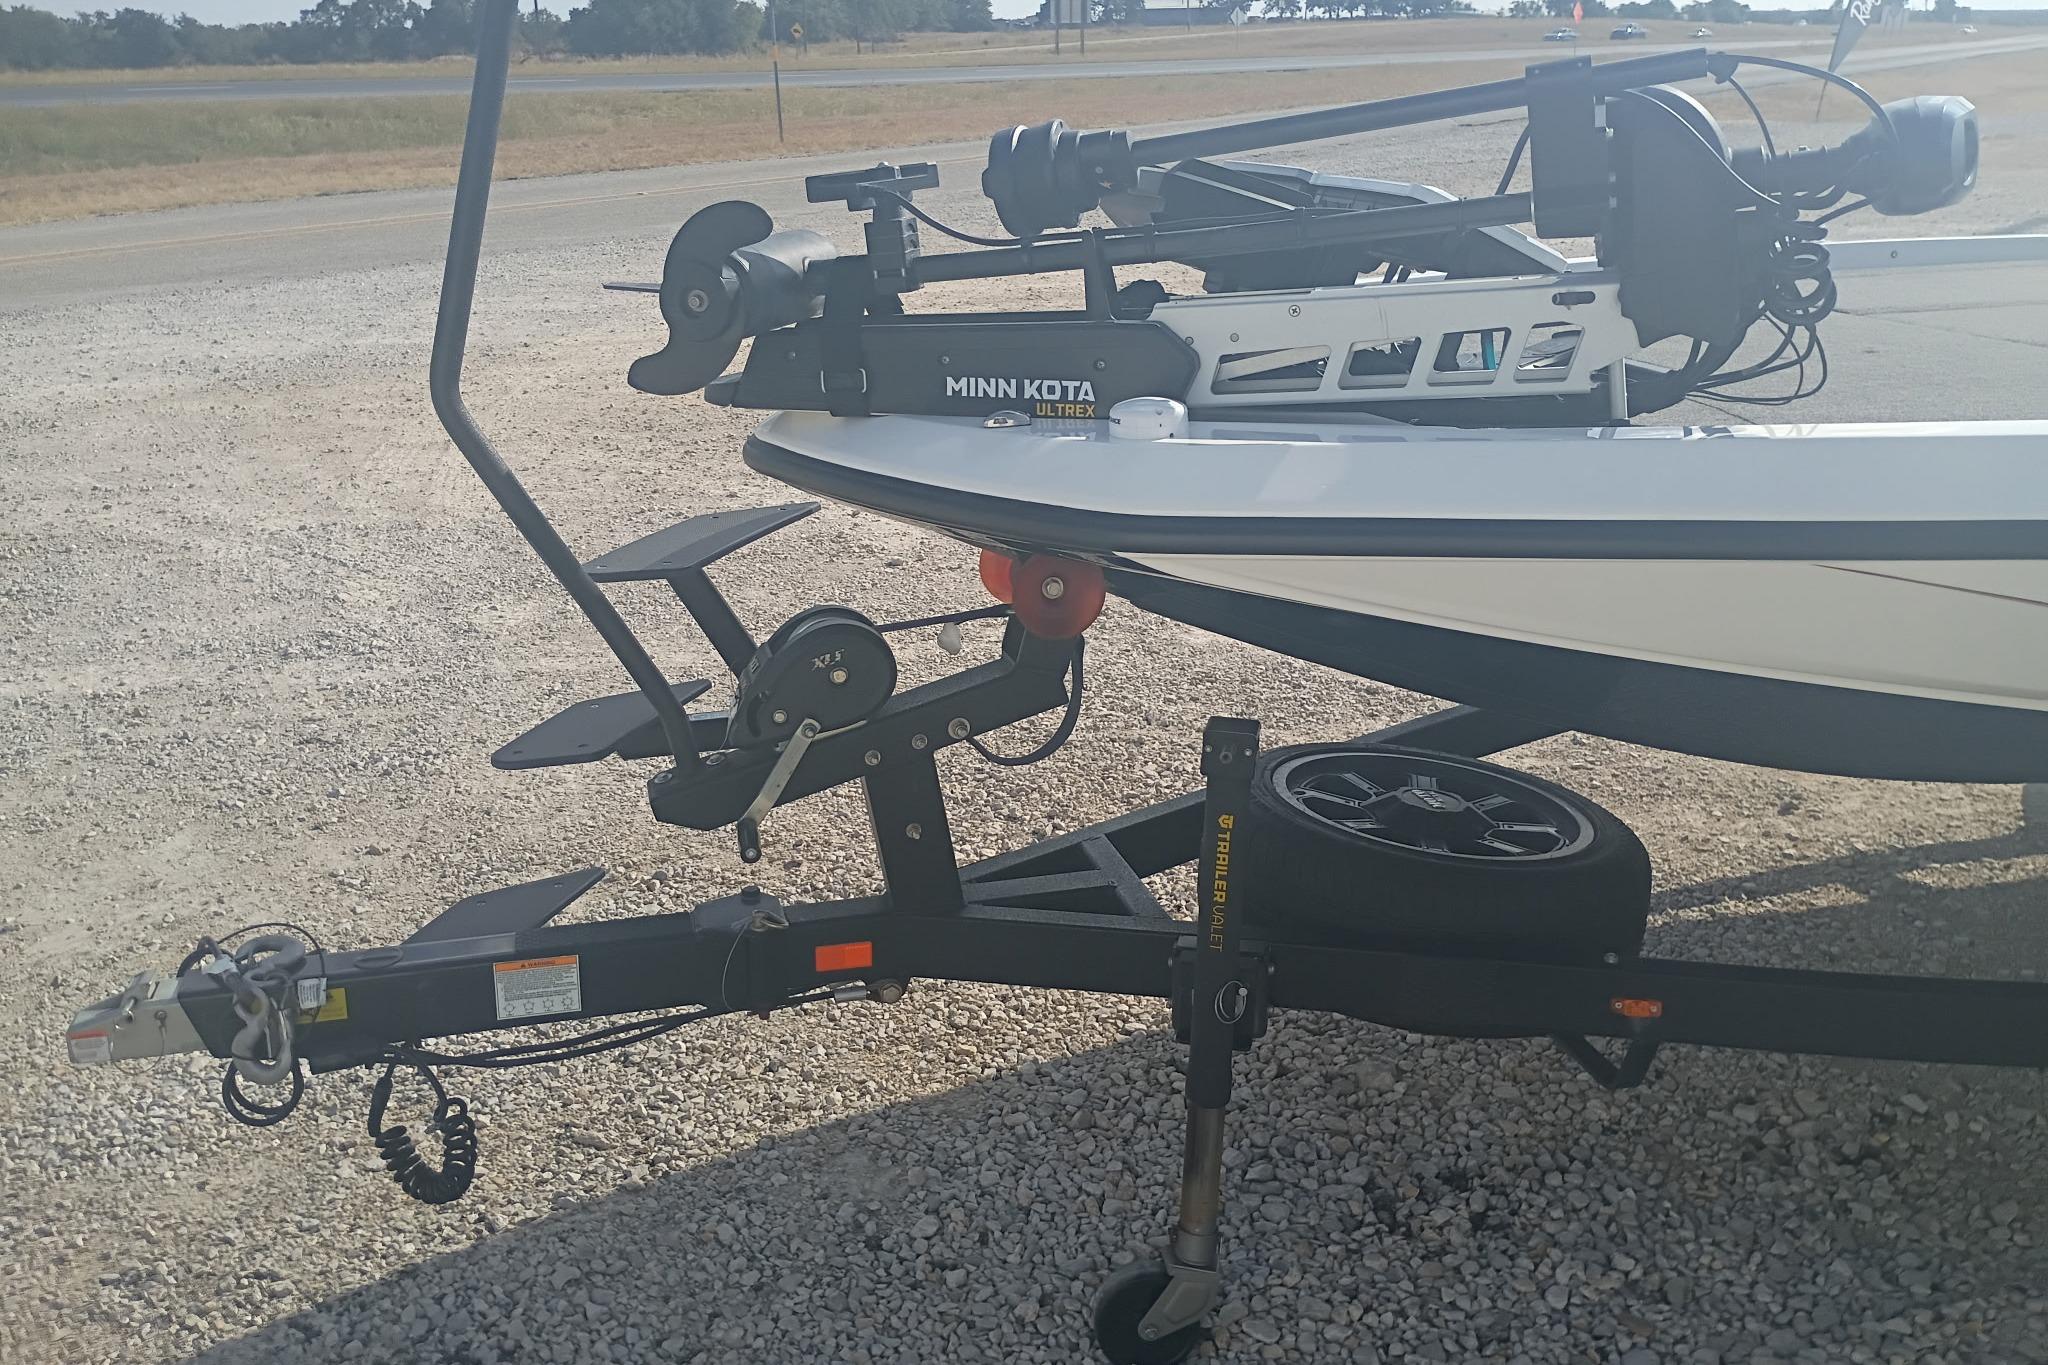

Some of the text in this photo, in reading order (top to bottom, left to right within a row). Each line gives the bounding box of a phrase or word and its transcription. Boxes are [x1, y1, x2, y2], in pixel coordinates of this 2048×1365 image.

[946, 376, 1096, 402] MINN KOTA
[1036, 402, 1096, 418] ULTREX
[1209, 831, 1231, 953] TRAILER VALET
